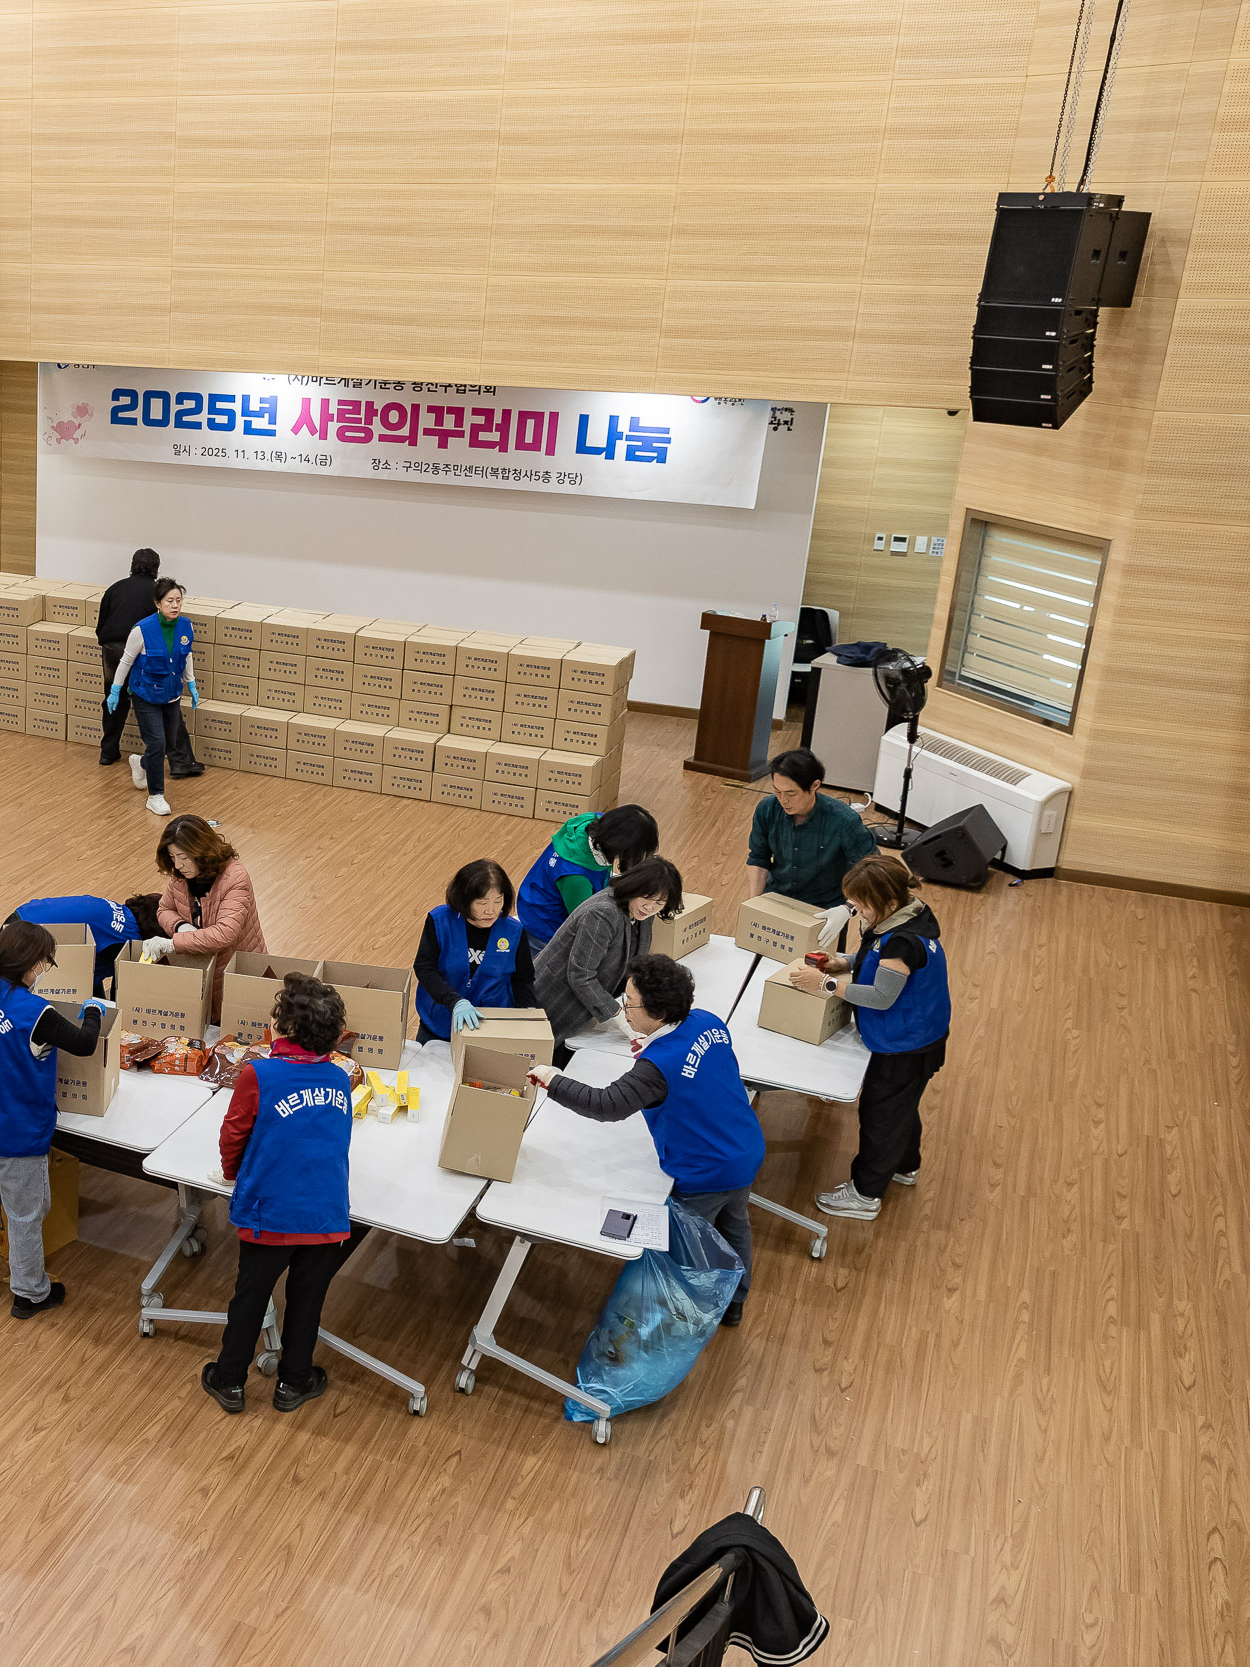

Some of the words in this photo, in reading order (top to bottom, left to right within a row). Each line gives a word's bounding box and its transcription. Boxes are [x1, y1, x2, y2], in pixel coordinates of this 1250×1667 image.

[110, 388, 278, 437] 2025년
[290, 397, 560, 456] 사랑의꾸러미
[575, 413, 672, 464] 나눔
[172, 443, 192, 457] 일시
[200, 446, 230, 459] 2025.
[234, 449, 249, 460] 11.
[253, 450, 288, 463] 13.(목)
[371, 458, 392, 471] 장소
[680, 1028, 730, 1079] 바르게살기운동
[273, 1087, 349, 1119] 바르게살기운동
